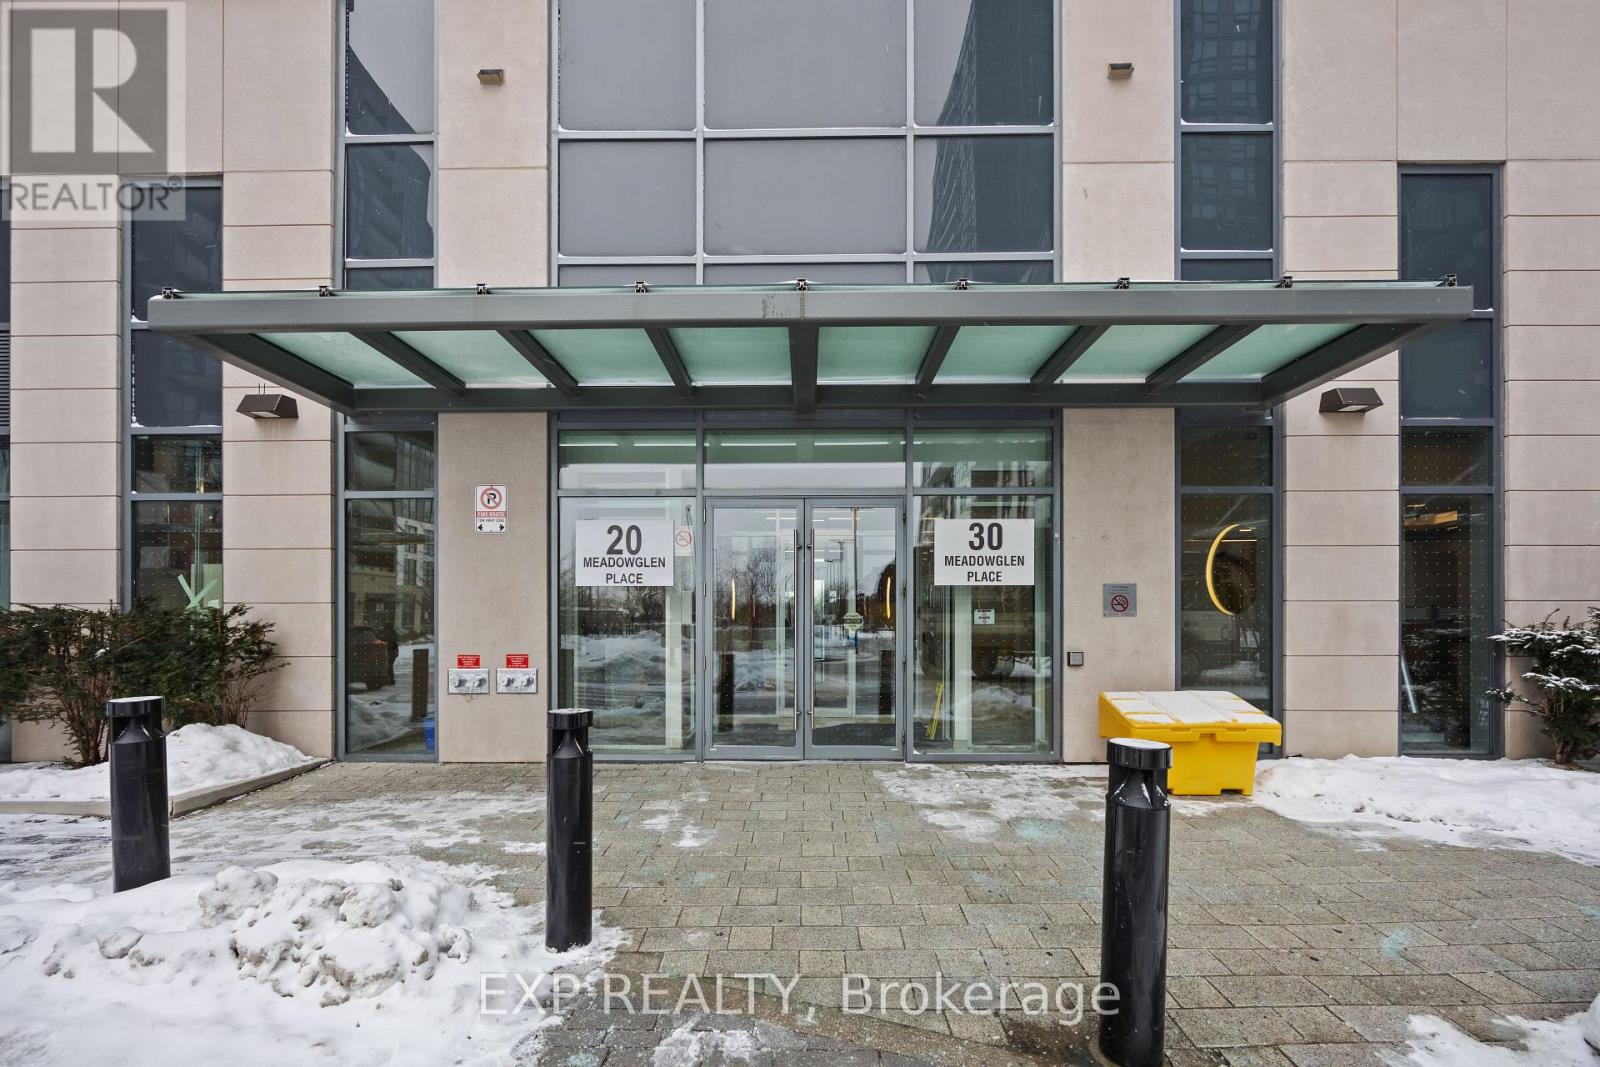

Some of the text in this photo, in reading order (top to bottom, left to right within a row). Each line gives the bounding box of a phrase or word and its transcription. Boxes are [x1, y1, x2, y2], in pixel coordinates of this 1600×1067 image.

[606, 524, 642, 555] 20
[968, 522, 1003, 551] 30
[583, 557, 666, 568] MEADOWGLEN
[944, 555, 1025, 567] MEADOWGLEN
[605, 573, 643, 584] PLACE
[967, 571, 1003, 582] PLACE
